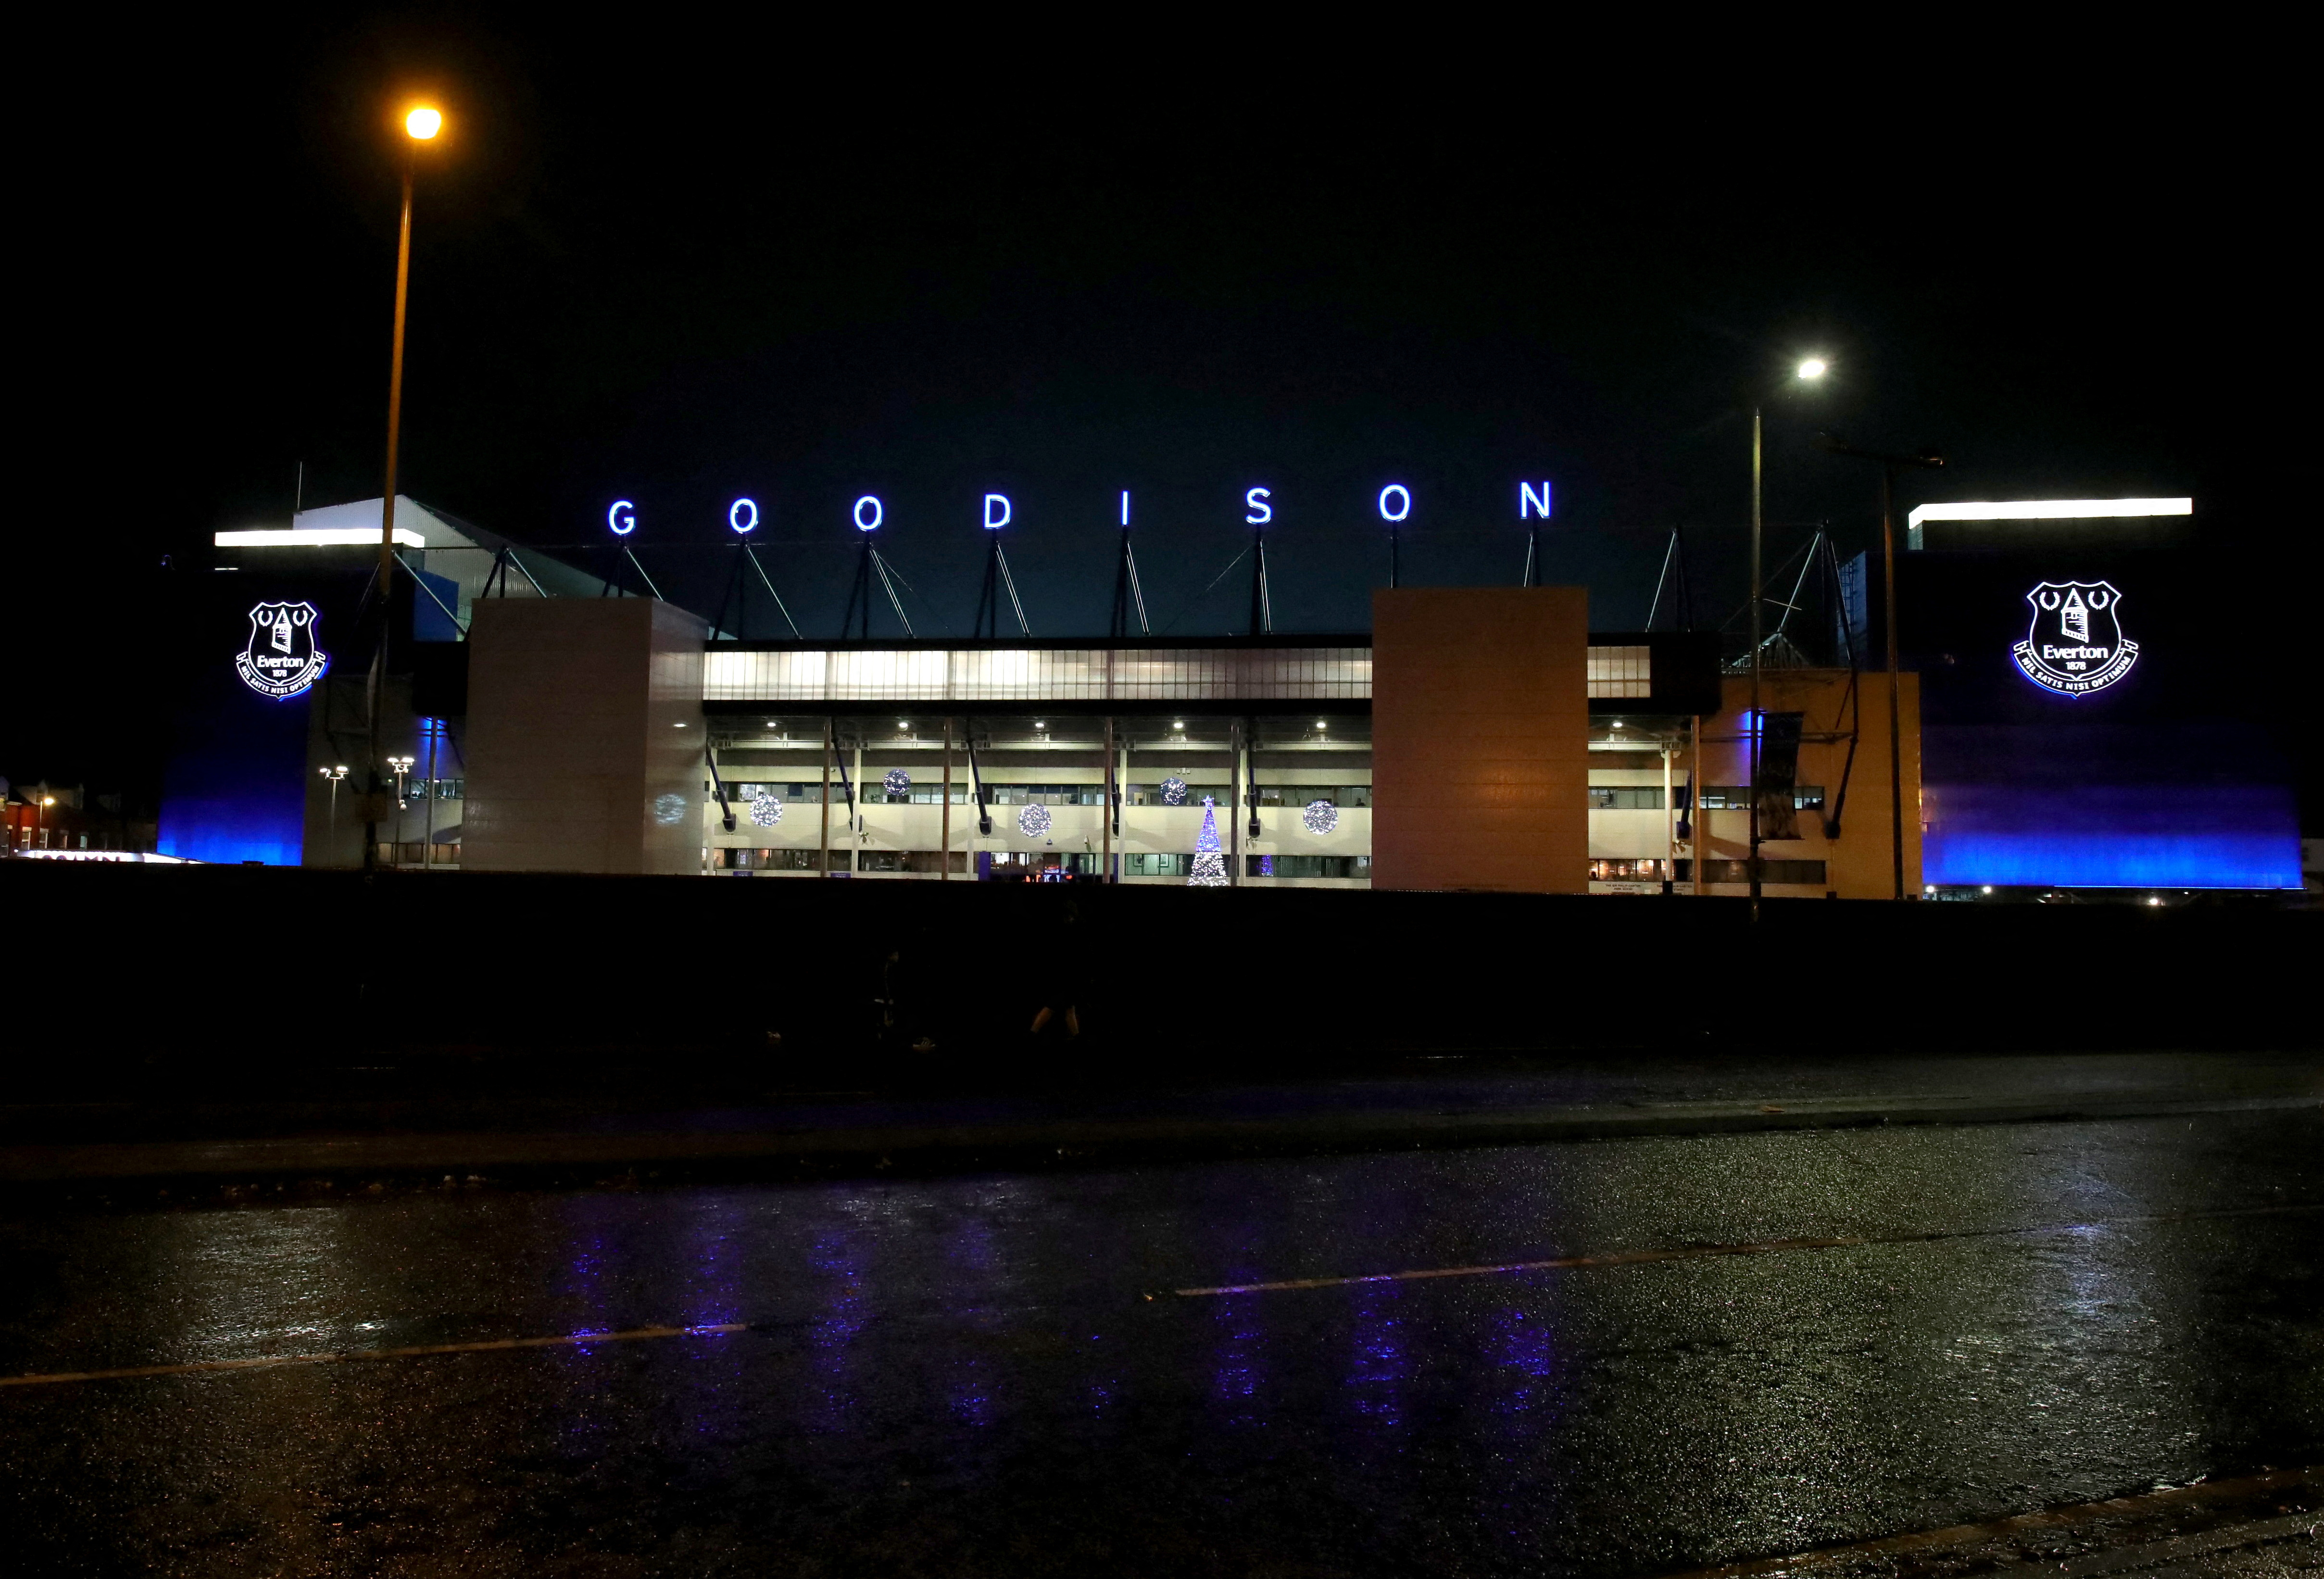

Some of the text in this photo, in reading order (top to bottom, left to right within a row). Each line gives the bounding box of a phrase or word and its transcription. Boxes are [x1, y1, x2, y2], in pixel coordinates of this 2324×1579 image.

[607, 481, 1553, 535] GOODISON
[257, 655, 304, 668] Everton
[2043, 645, 2109, 659] Everton
[2021, 655, 2132, 690] NIL SATIS NISI OPTIMUM
[2065, 661, 2086, 670] 1878
[241, 665, 251, 680] NIL
[250, 677, 270, 692] SATIS
[289, 665, 320, 691] OPTIMUM
